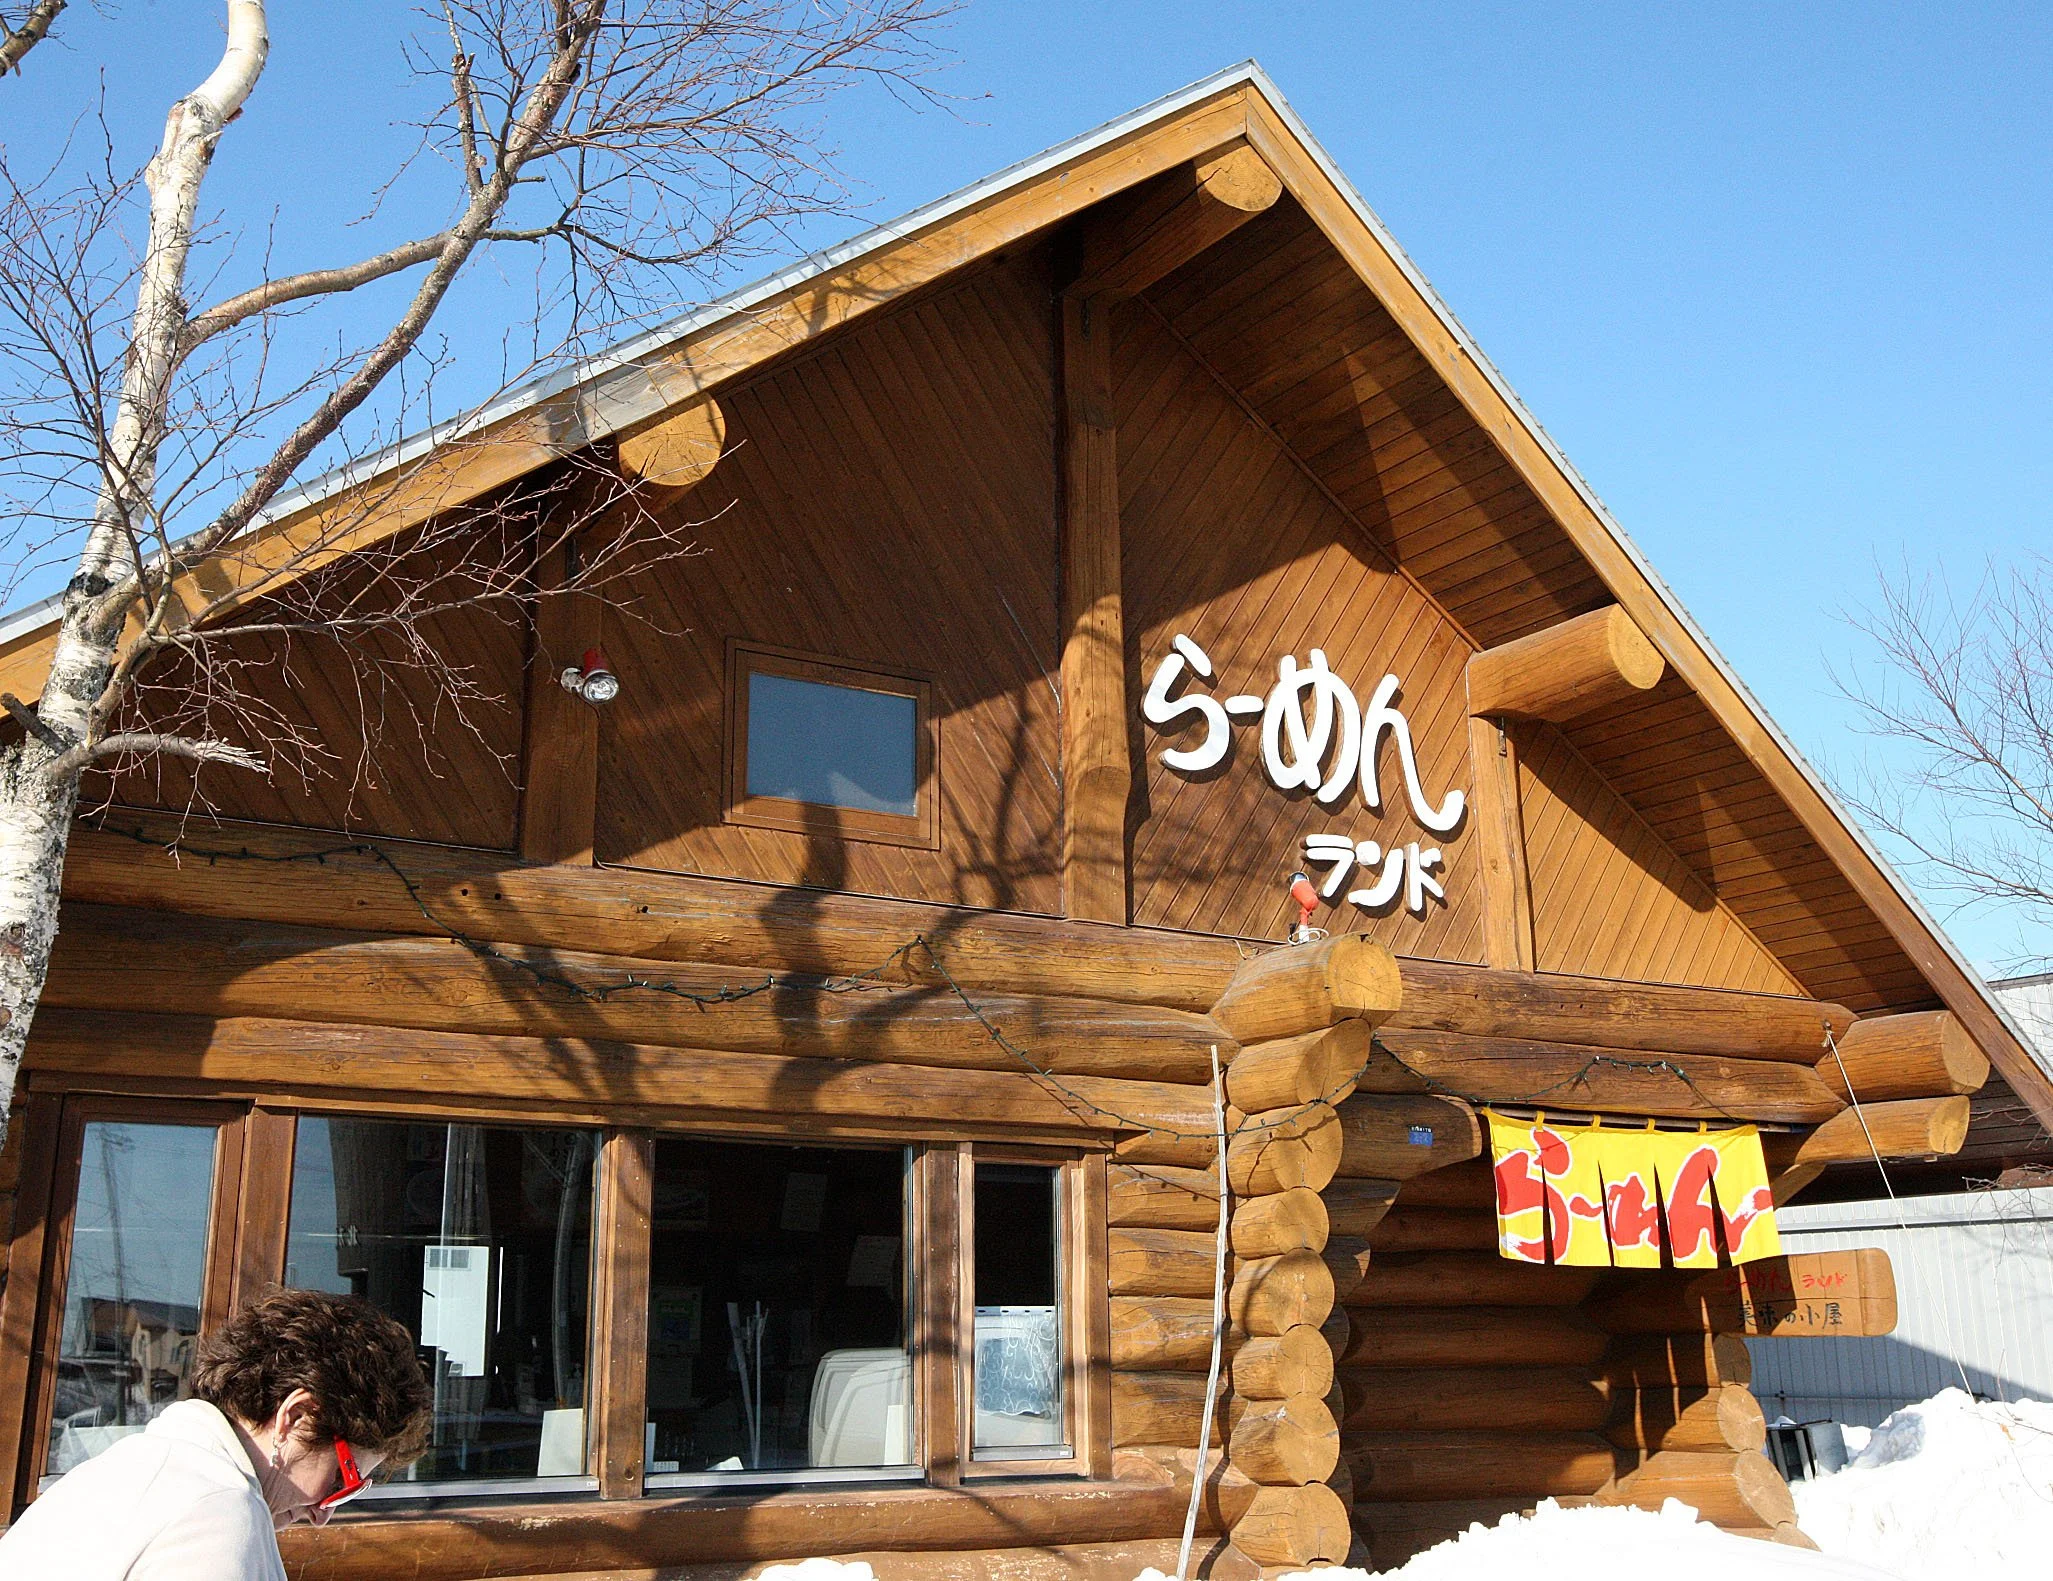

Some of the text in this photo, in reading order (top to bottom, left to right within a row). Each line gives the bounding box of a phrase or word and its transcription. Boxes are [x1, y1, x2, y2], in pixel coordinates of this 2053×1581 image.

[1143, 633, 1465, 832] らーめん
[1304, 834, 1444, 912] ランド
[1737, 1300, 1843, 1330] 美味の小屋
